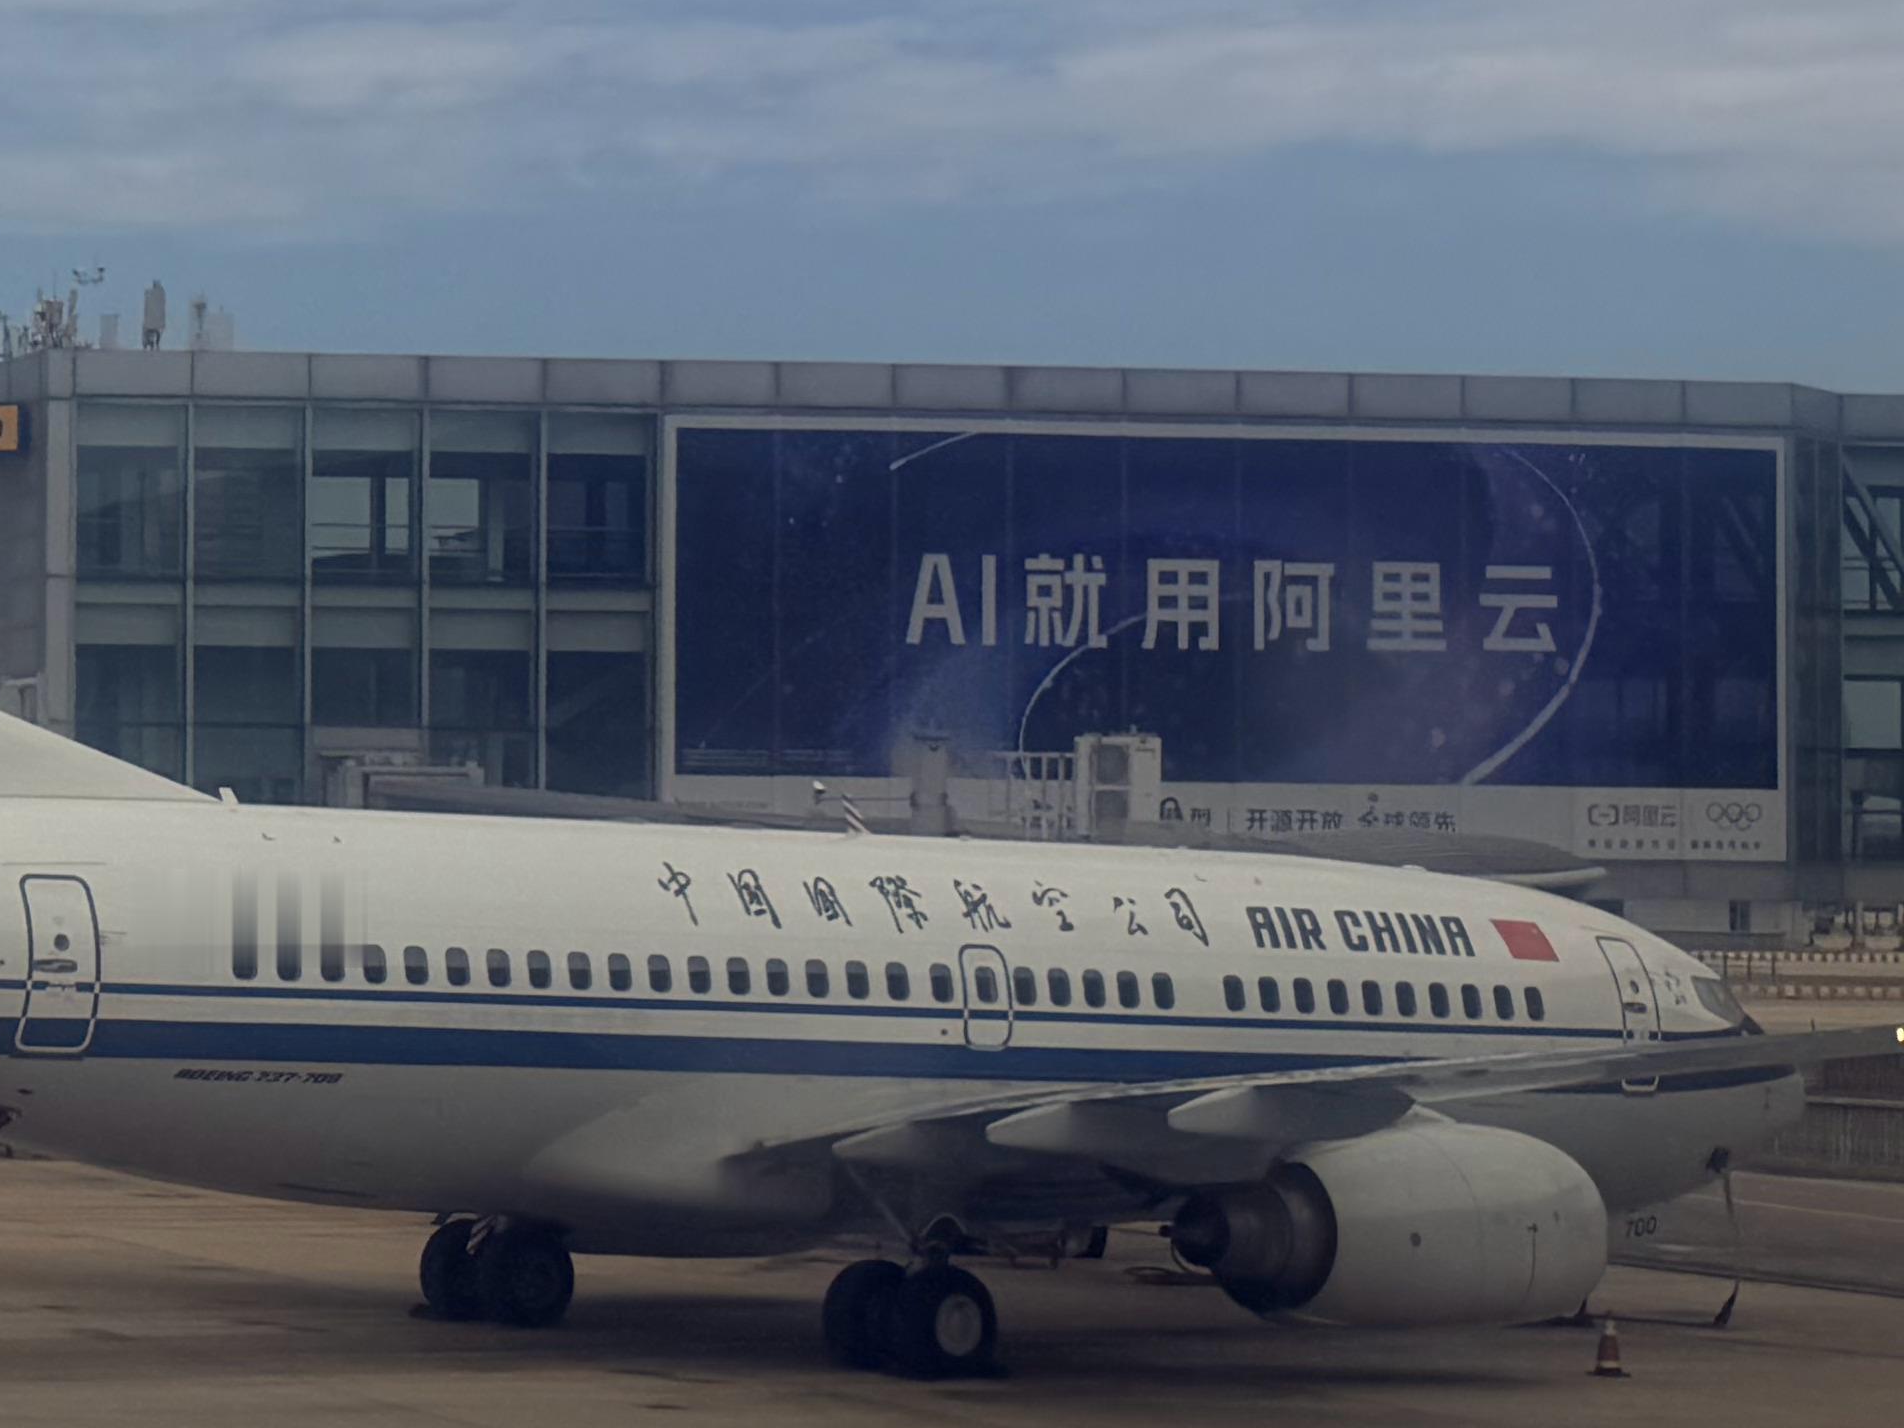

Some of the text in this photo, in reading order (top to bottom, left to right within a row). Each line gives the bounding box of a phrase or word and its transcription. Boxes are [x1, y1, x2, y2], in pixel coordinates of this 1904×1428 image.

[905, 552, 1558, 653] AI就用阿里云
[1622, 804, 1677, 827] 阿里云
[1245, 905, 1476, 957] AIR CHINA
